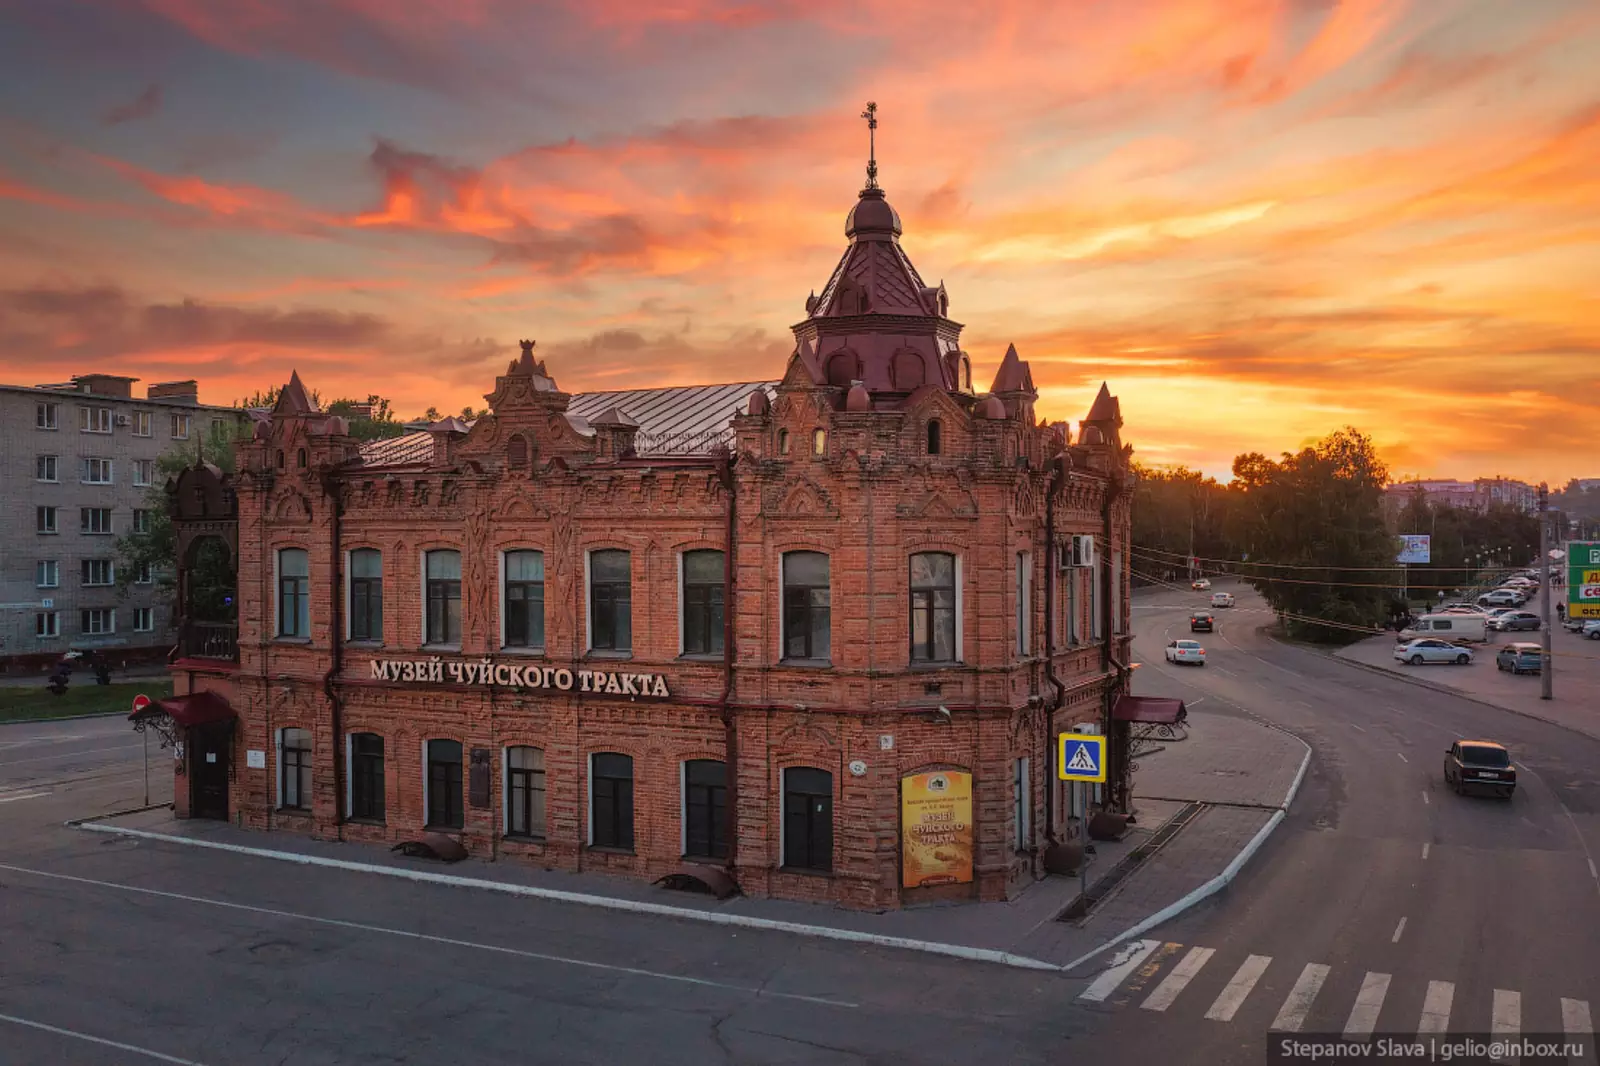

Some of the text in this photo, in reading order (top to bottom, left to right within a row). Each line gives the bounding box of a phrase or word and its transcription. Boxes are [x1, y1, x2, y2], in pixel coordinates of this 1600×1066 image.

[1588, 572, 1600, 583] Д
[370, 656, 669, 697] МУЗЕЙ ЧУЙСКОГО ТРАКТА
